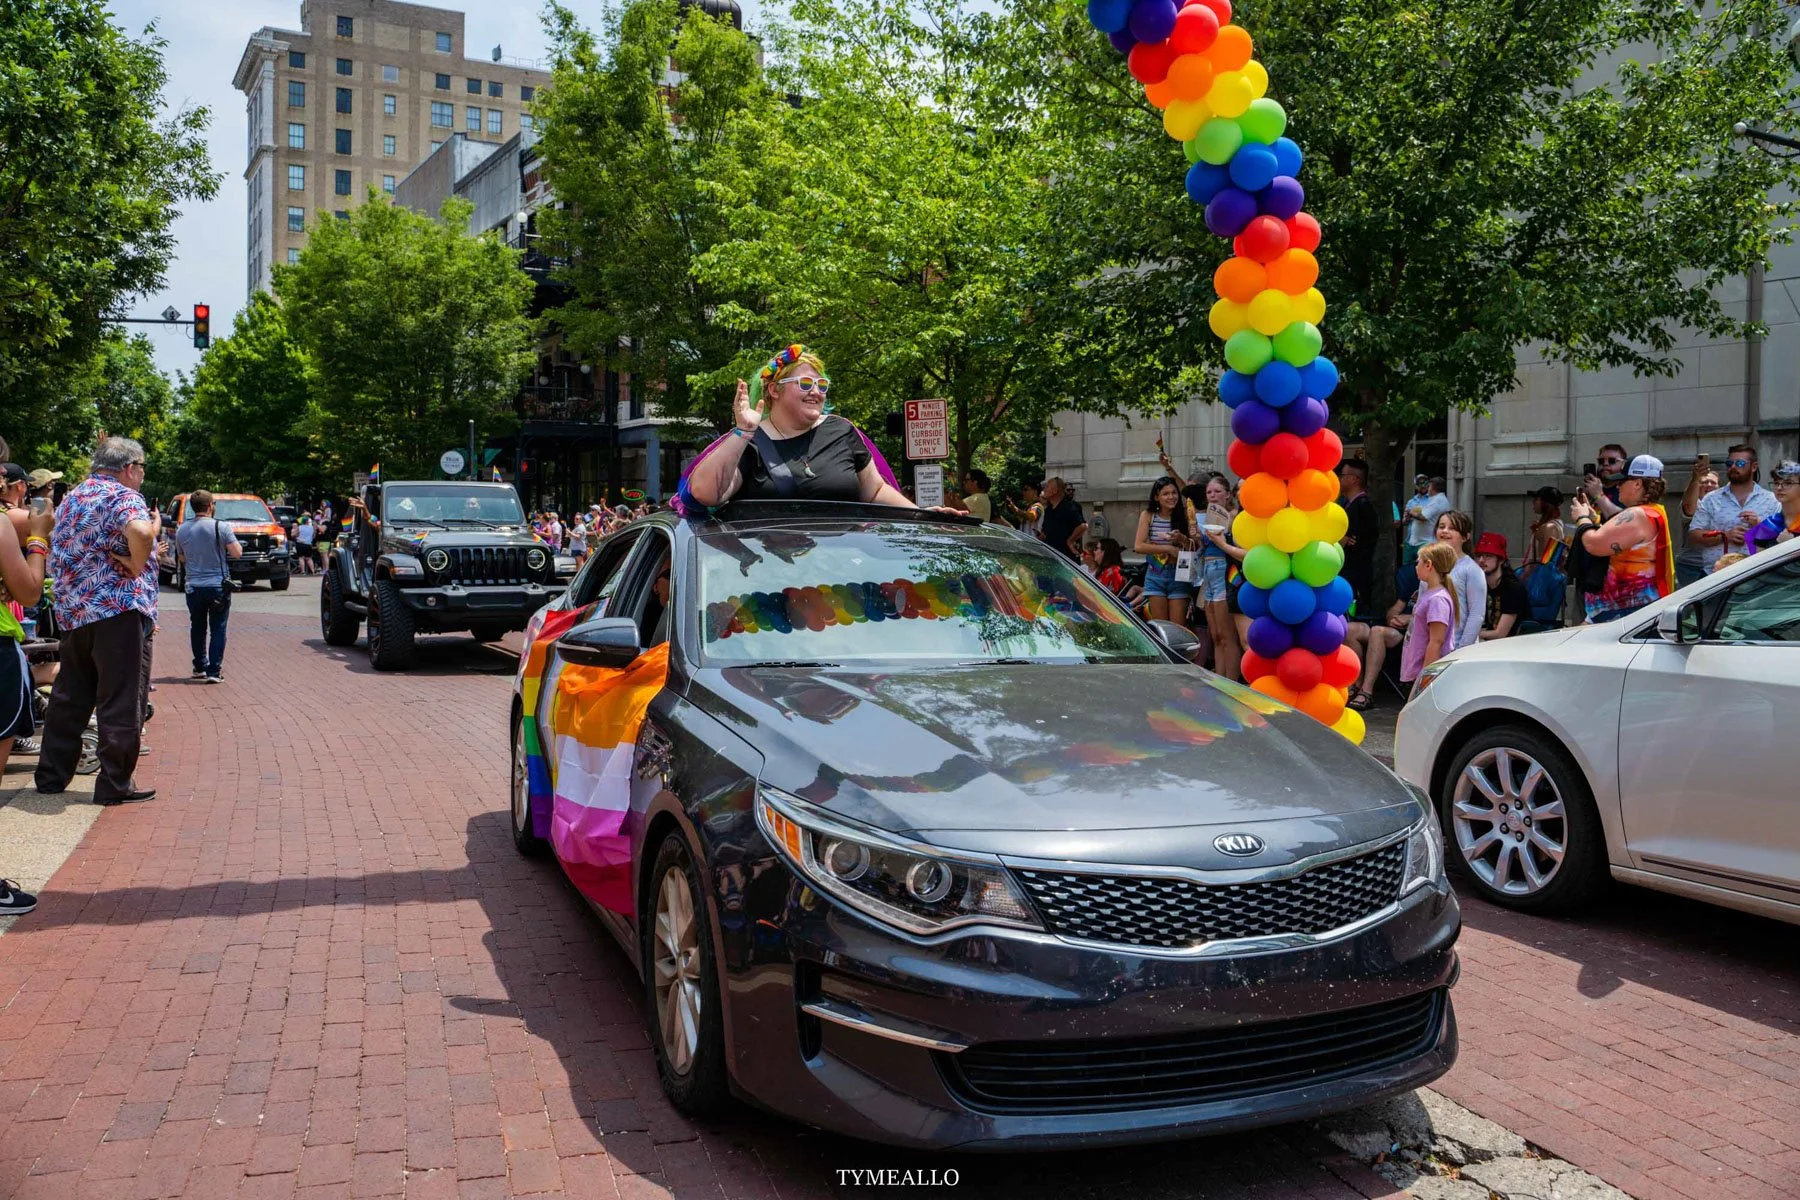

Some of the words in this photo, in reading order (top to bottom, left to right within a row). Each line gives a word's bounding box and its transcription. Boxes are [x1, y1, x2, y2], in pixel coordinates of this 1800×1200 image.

[922, 402, 941, 410] MINUTE
[908, 404, 917, 418] 5
[920, 410, 943, 418] PARKING
[910, 421, 943, 429] DROP-OFF
[911, 430, 943, 438] CURBSIDE
[914, 438, 941, 446] SERVICE
[919, 447, 937, 455] ONLY
[1217, 835, 1261, 851] KIA
